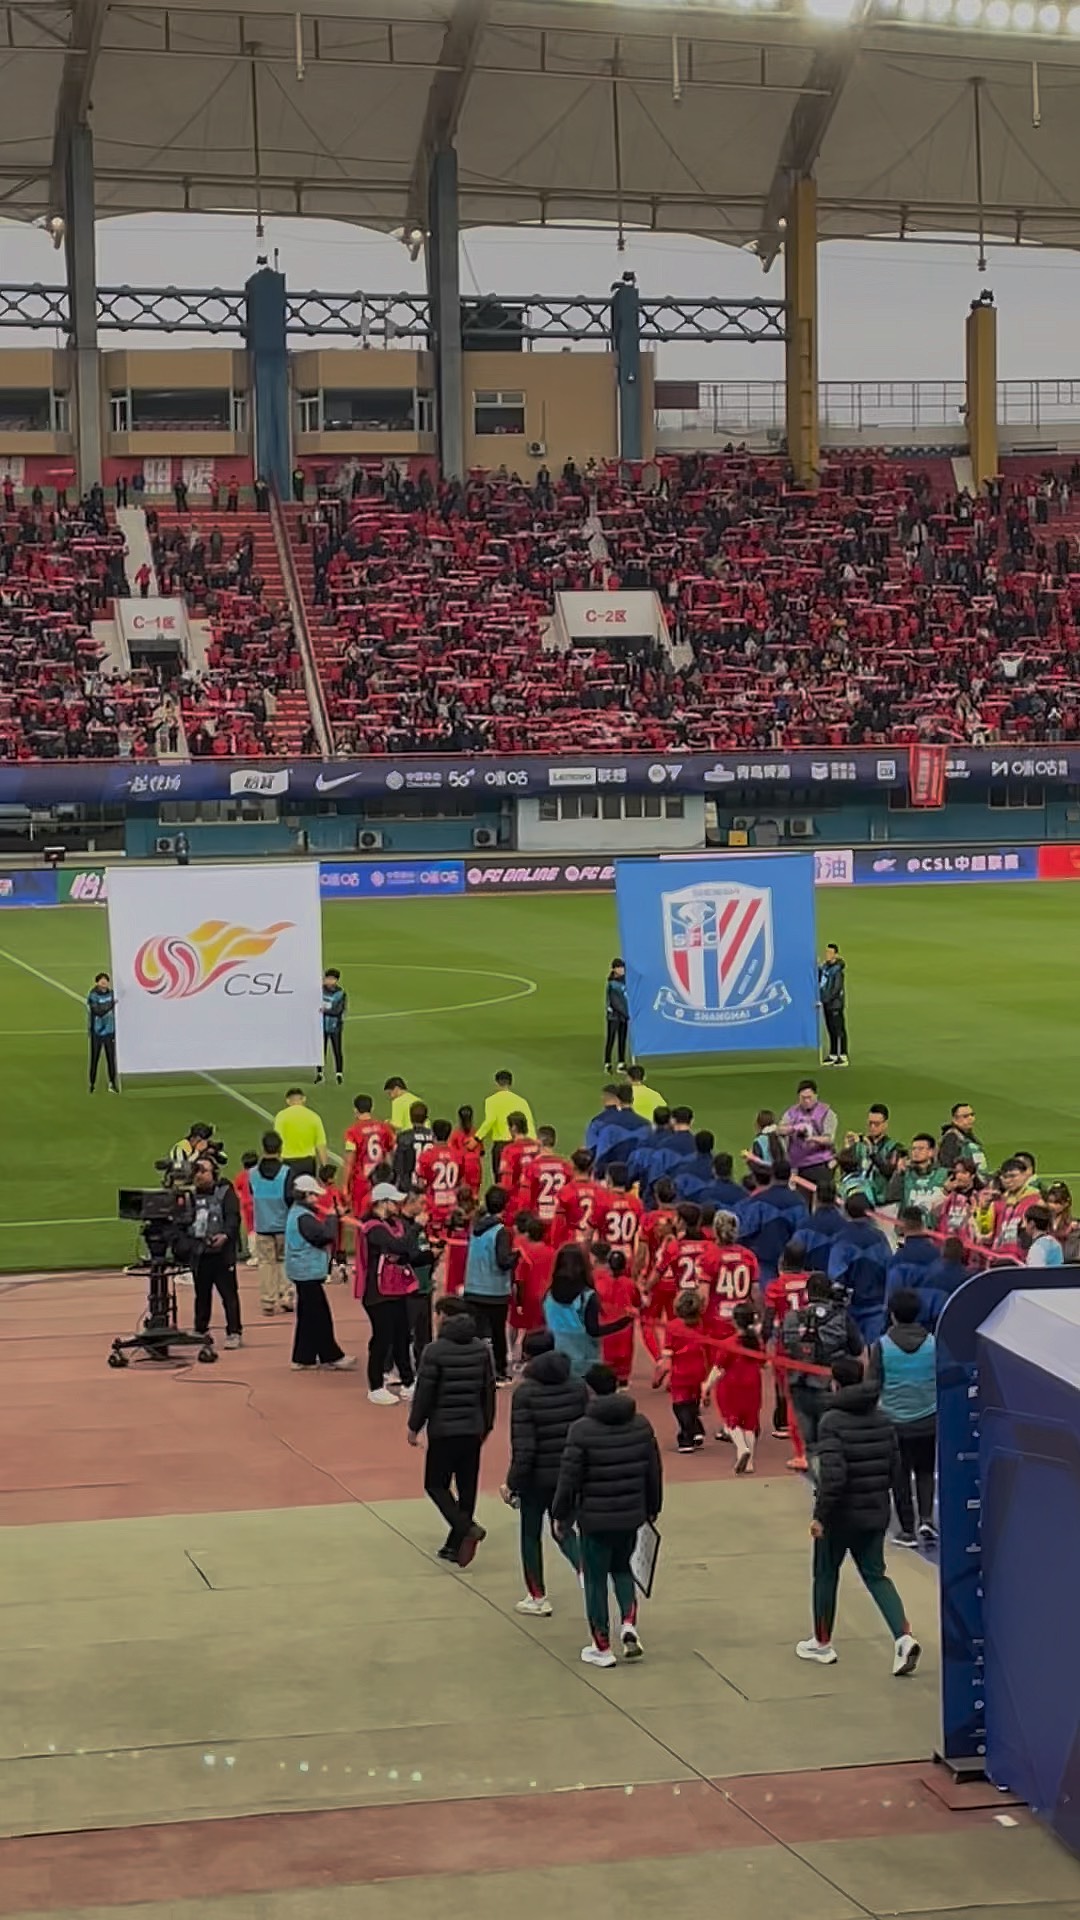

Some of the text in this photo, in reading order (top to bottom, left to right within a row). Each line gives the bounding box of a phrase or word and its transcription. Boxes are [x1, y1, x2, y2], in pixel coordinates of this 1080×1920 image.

[133, 615, 176, 629] C-1区
[586, 609, 627, 623] C-2区
[448, 770, 471, 787] 5G
[815, 856, 848, 880] 油
[674, 931, 717, 948] SFC
[224, 972, 294, 996] CSL
[694, 1010, 751, 1021] SHANGHAI
[367, 1134, 382, 1161] 6
[432, 1161, 459, 1190] 20
[606, 1210, 637, 1242] 30
[716, 1264, 751, 1300] 40
